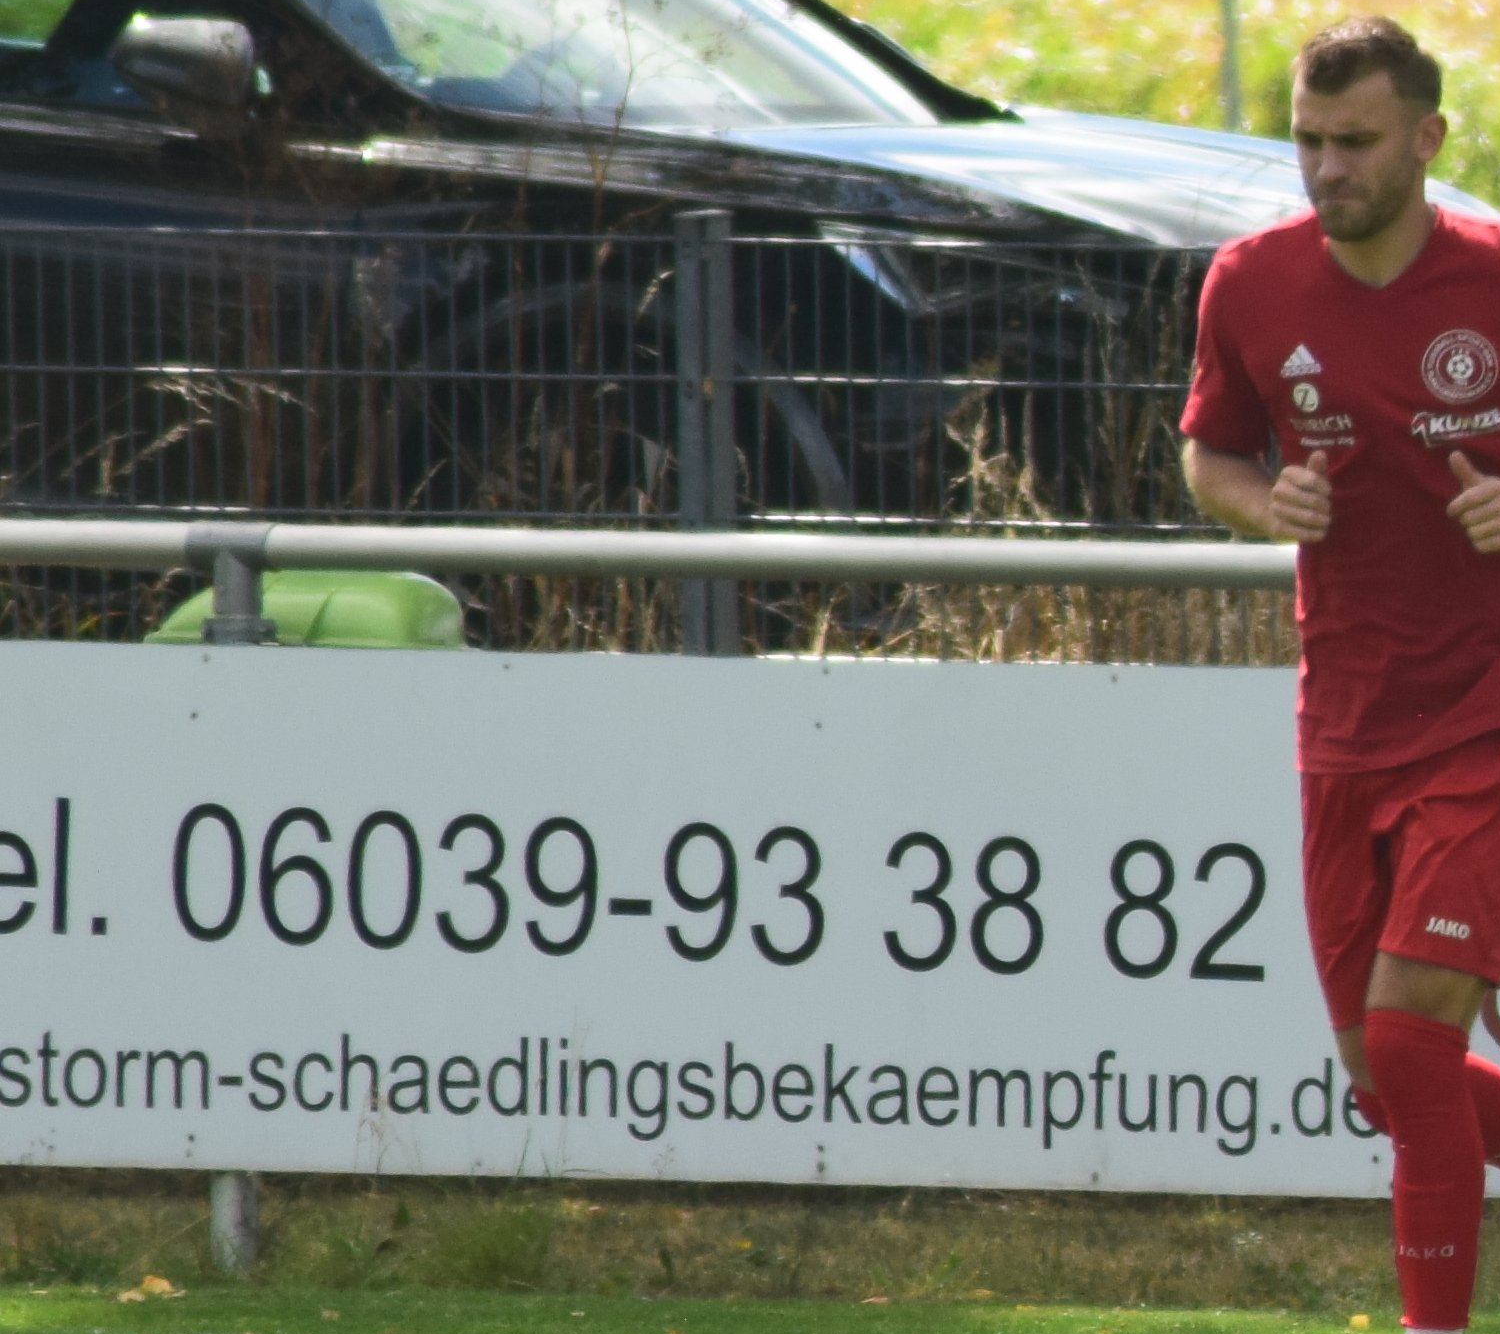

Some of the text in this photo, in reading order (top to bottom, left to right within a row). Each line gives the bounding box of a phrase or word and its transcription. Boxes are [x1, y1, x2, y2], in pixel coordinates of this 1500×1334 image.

[171, 802, 826, 967] 06039-93
[882, 830, 1045, 975] 38
[1103, 838, 1268, 983] 82
[1425, 916, 1471, 940] JAKO
